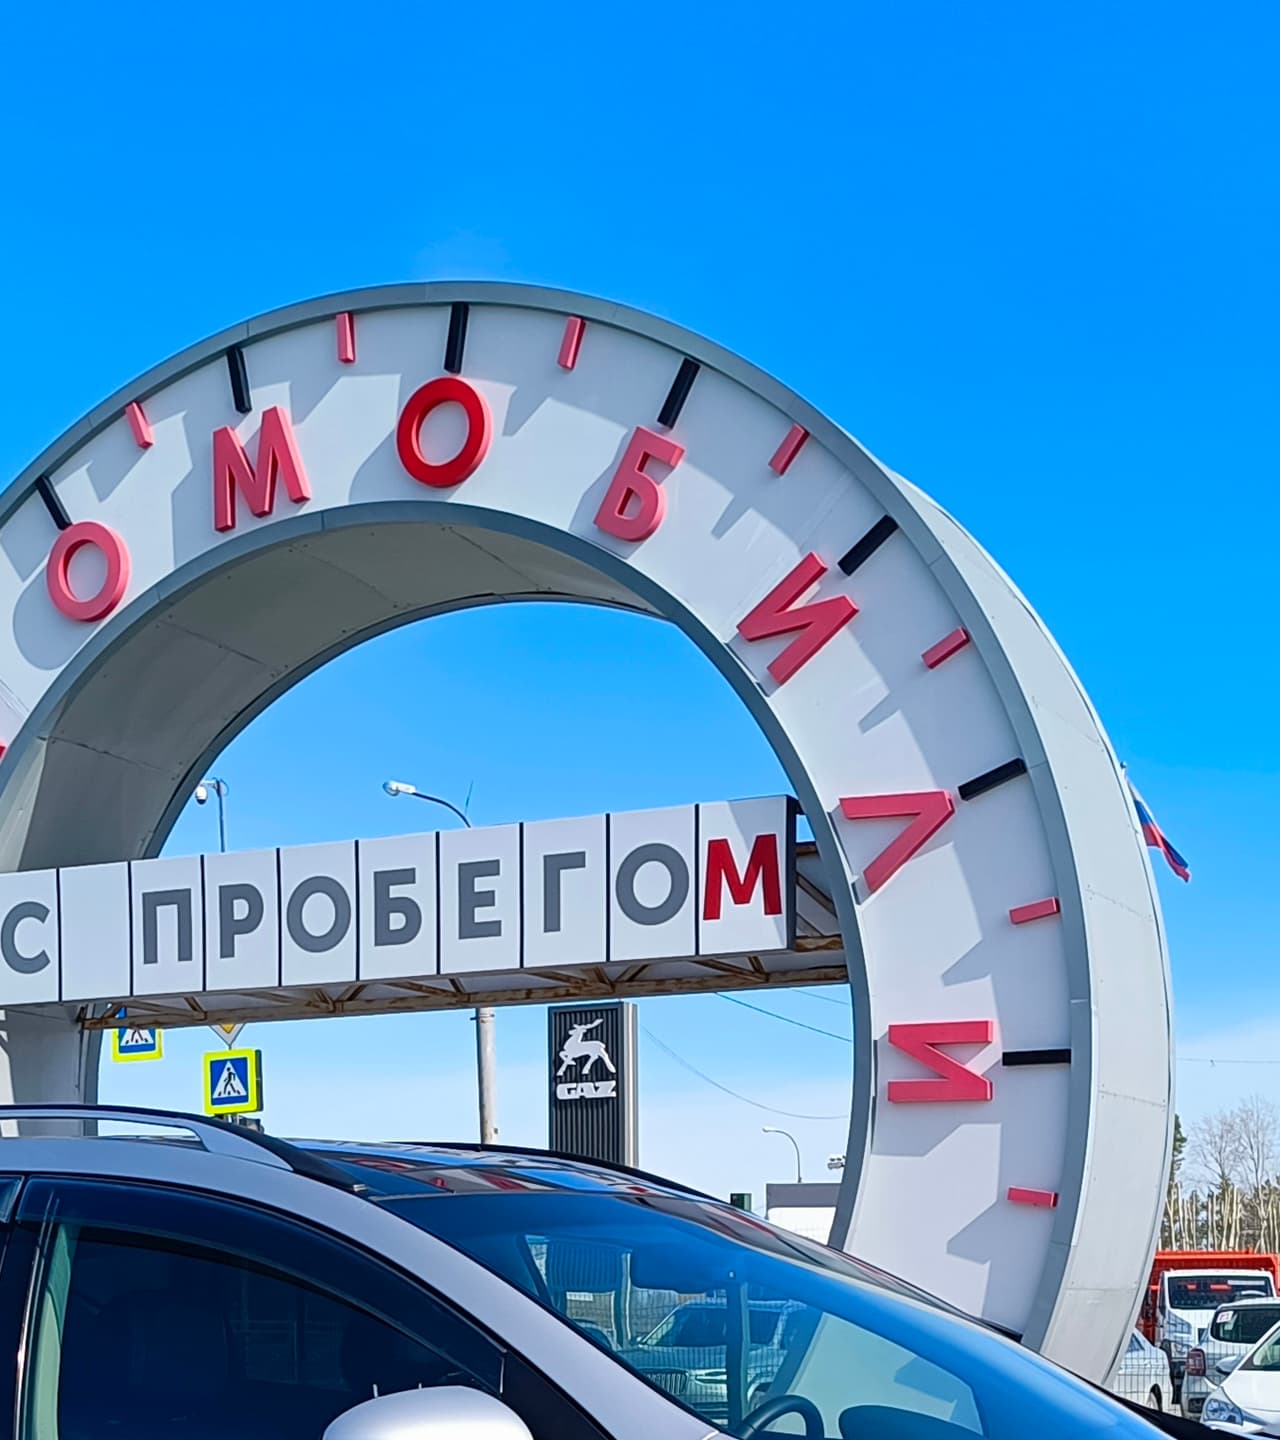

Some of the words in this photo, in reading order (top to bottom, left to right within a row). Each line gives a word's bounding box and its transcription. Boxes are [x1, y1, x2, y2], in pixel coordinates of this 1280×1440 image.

[0, 900, 51, 975] С
[141, 833, 783, 966] ПРОБЕГОМ
[556, 1080, 617, 1100] GAZ
